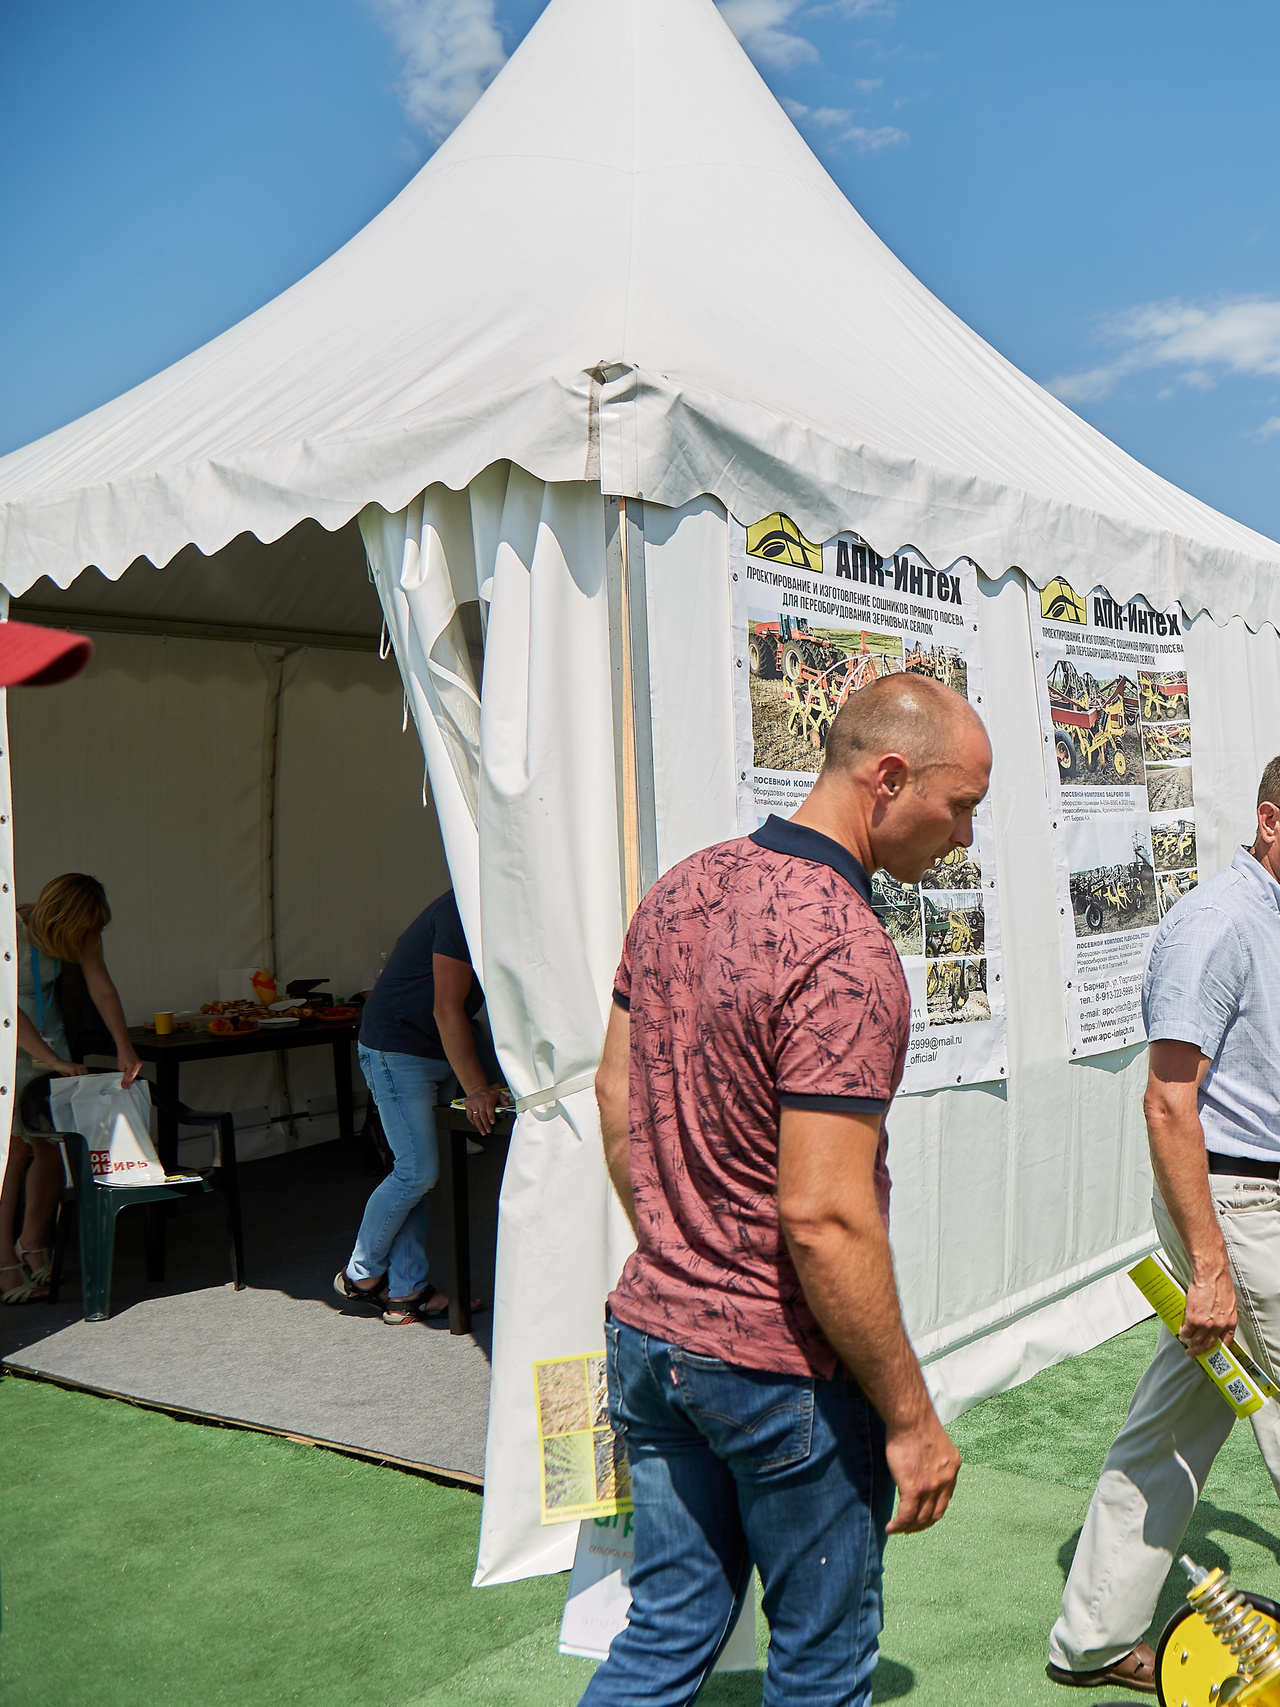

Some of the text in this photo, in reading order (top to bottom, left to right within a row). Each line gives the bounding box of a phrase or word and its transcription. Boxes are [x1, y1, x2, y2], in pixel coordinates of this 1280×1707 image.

[836, 539, 962, 605] АПК-Интех
[746, 565, 964, 627] ПРОЕКТИРОВАНИЕ И ИЗГОТОВЛЕНИЕ СОШНИКОВ ПРЯМОГО ПОСЕВА
[782, 592, 934, 636] ДЛЯ ПЕРЕОБОРУДОВАНИЯ ЗЕРНОВЫХ СЕЯЛОК
[1093, 596, 1182, 636] АПК-Интех
[1042, 626, 1081, 642] ПРОЕКТИРОВАНИЕ
[1081, 633, 1085, 643] И
[1116, 640, 1139, 651] СОШНИКОВ
[1139, 642, 1159, 654] ПРЯМОГО
[1159, 644, 1184, 654] ПОСЕВА
[753, 776, 791, 787] ПОСЕВНОЙ
[753, 787, 786, 797] оборудован
[754, 797, 783, 806] Алтайский
[1076, 941, 1104, 949] ПОСЕВНОЙ
[1080, 1007, 1100, 1019] e-mail:
[911, 1022, 925, 1033] 199
